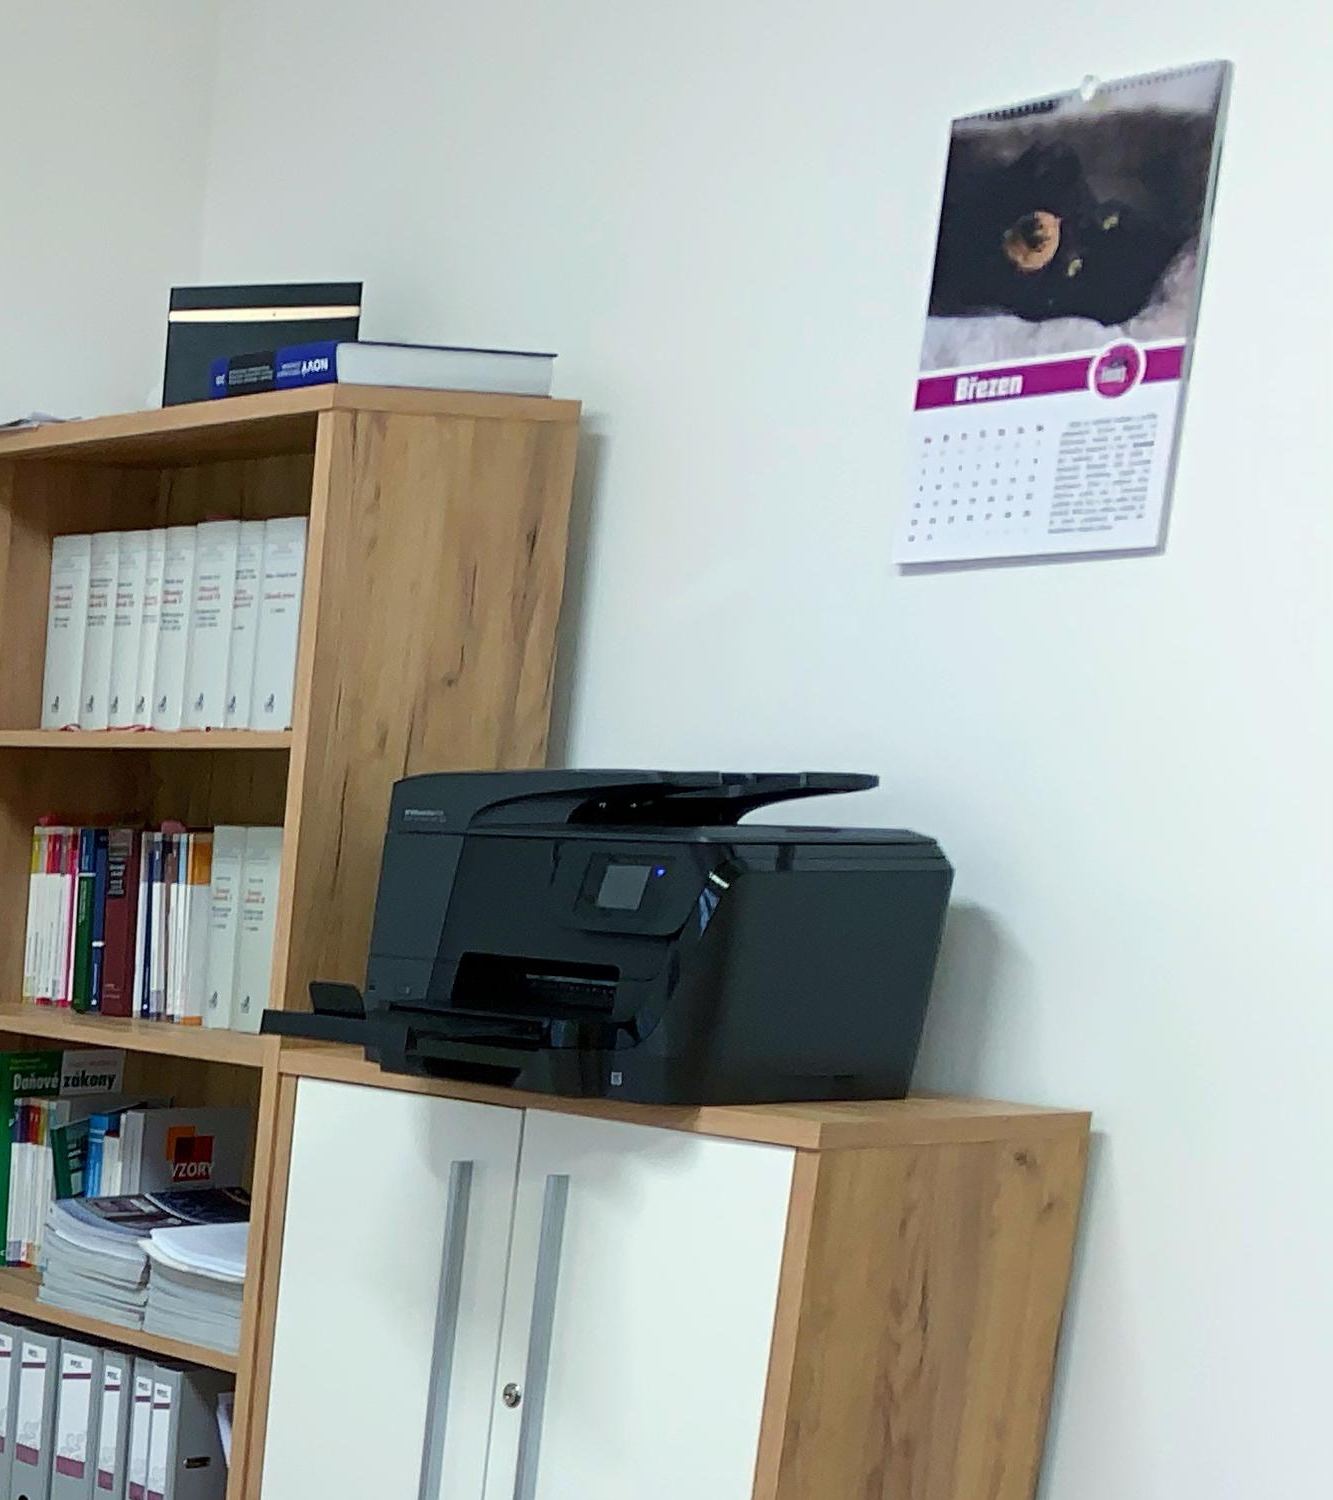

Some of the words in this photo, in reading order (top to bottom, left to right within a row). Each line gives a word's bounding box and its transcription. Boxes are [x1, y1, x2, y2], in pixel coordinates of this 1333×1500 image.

[953, 374, 1024, 403] Březen
[13, 1072, 59, 1091] Daňové
[63, 1070, 117, 1090] zákony
[171, 1162, 215, 1179] VZORY
